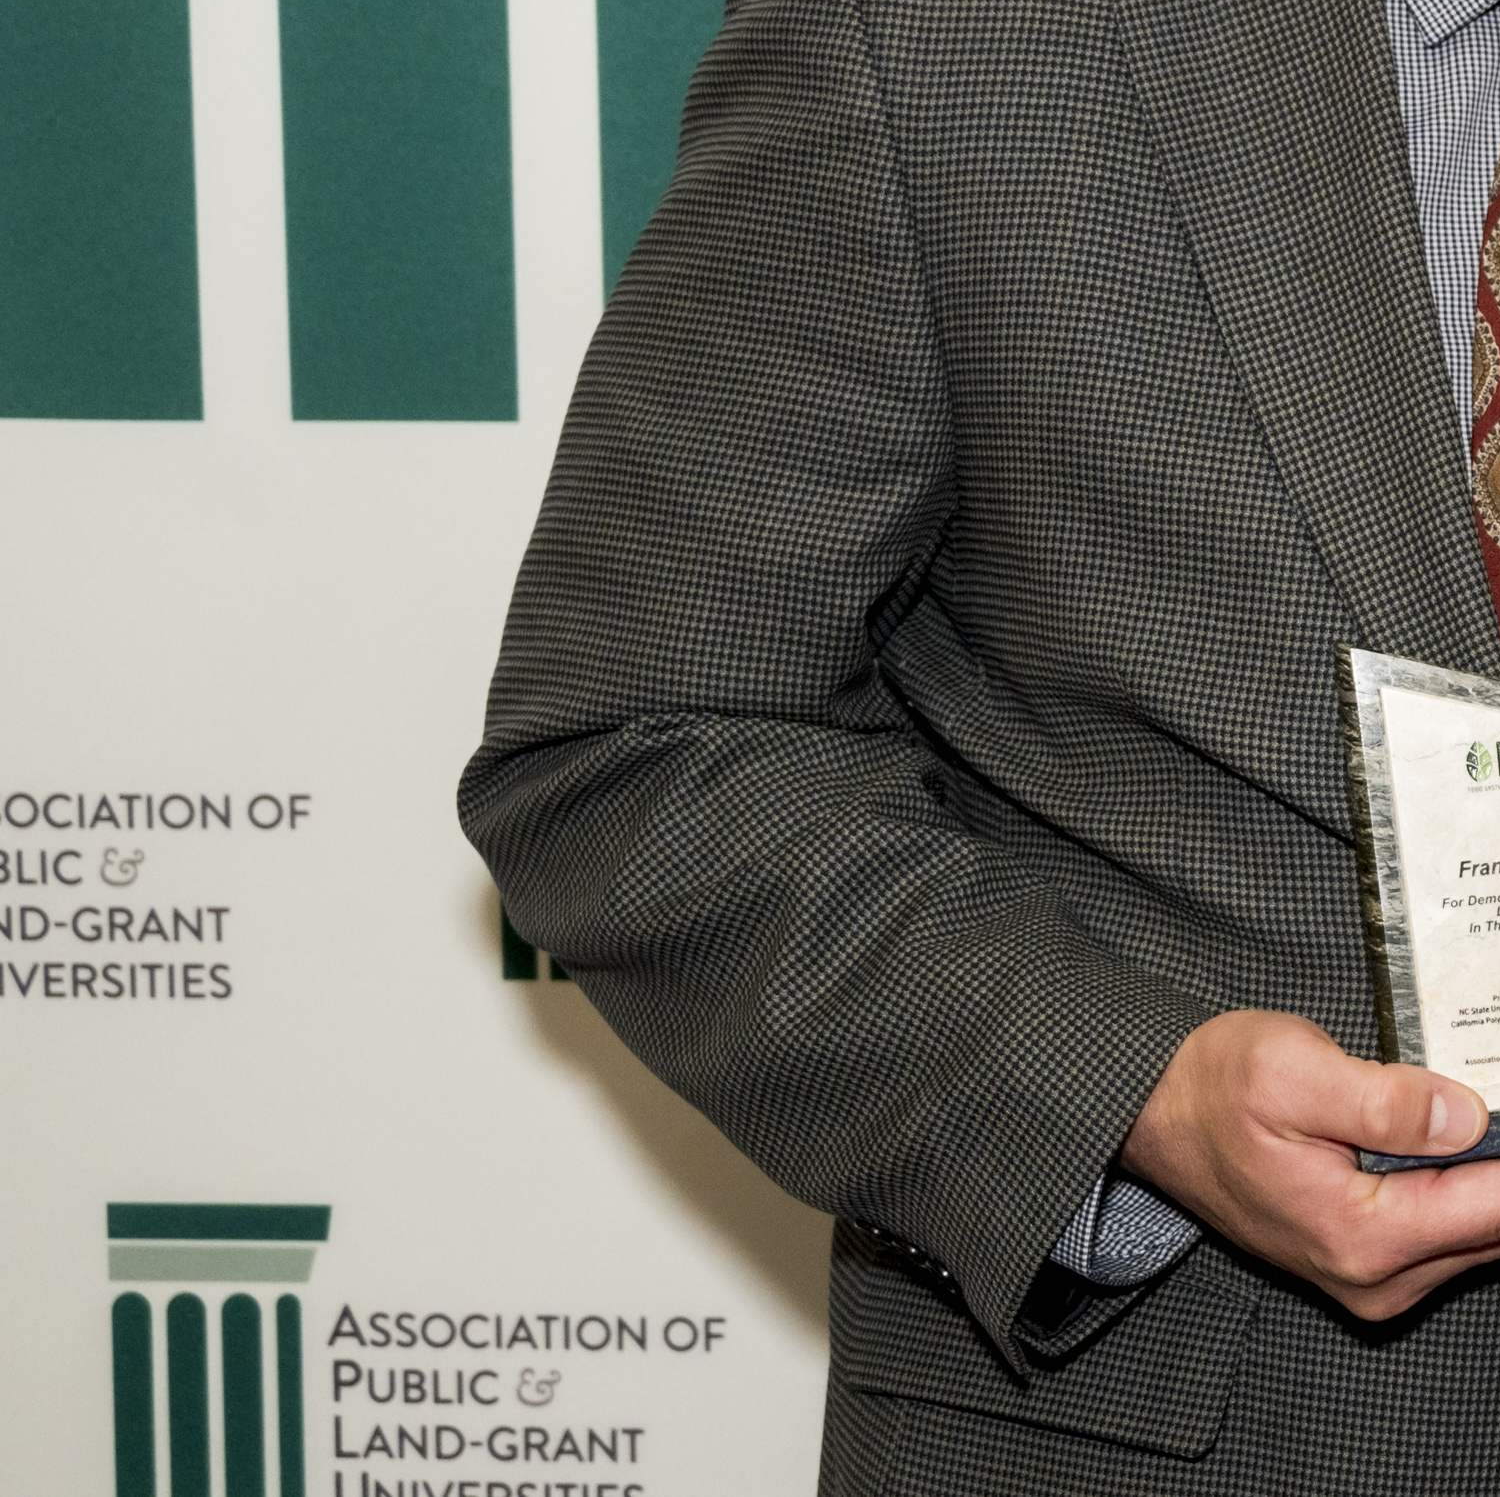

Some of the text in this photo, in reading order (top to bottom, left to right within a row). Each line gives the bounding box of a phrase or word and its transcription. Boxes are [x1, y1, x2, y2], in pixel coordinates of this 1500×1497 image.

[0, 792, 311, 830] OCIATION OF
[100, 846, 145, 887] &
[1442, 897, 1464, 908] For
[1469, 922, 1481, 933] In
[1451, 1018, 1484, 1028] California
[1459, 1008, 1470, 1016] NC
[1471, 1006, 1490, 1014] State
[328, 1304, 727, 1353] ASSOCIATION OF
[332, 1359, 562, 1407] PUBLIC &
[333, 1415, 645, 1463] LAND-GRANT
